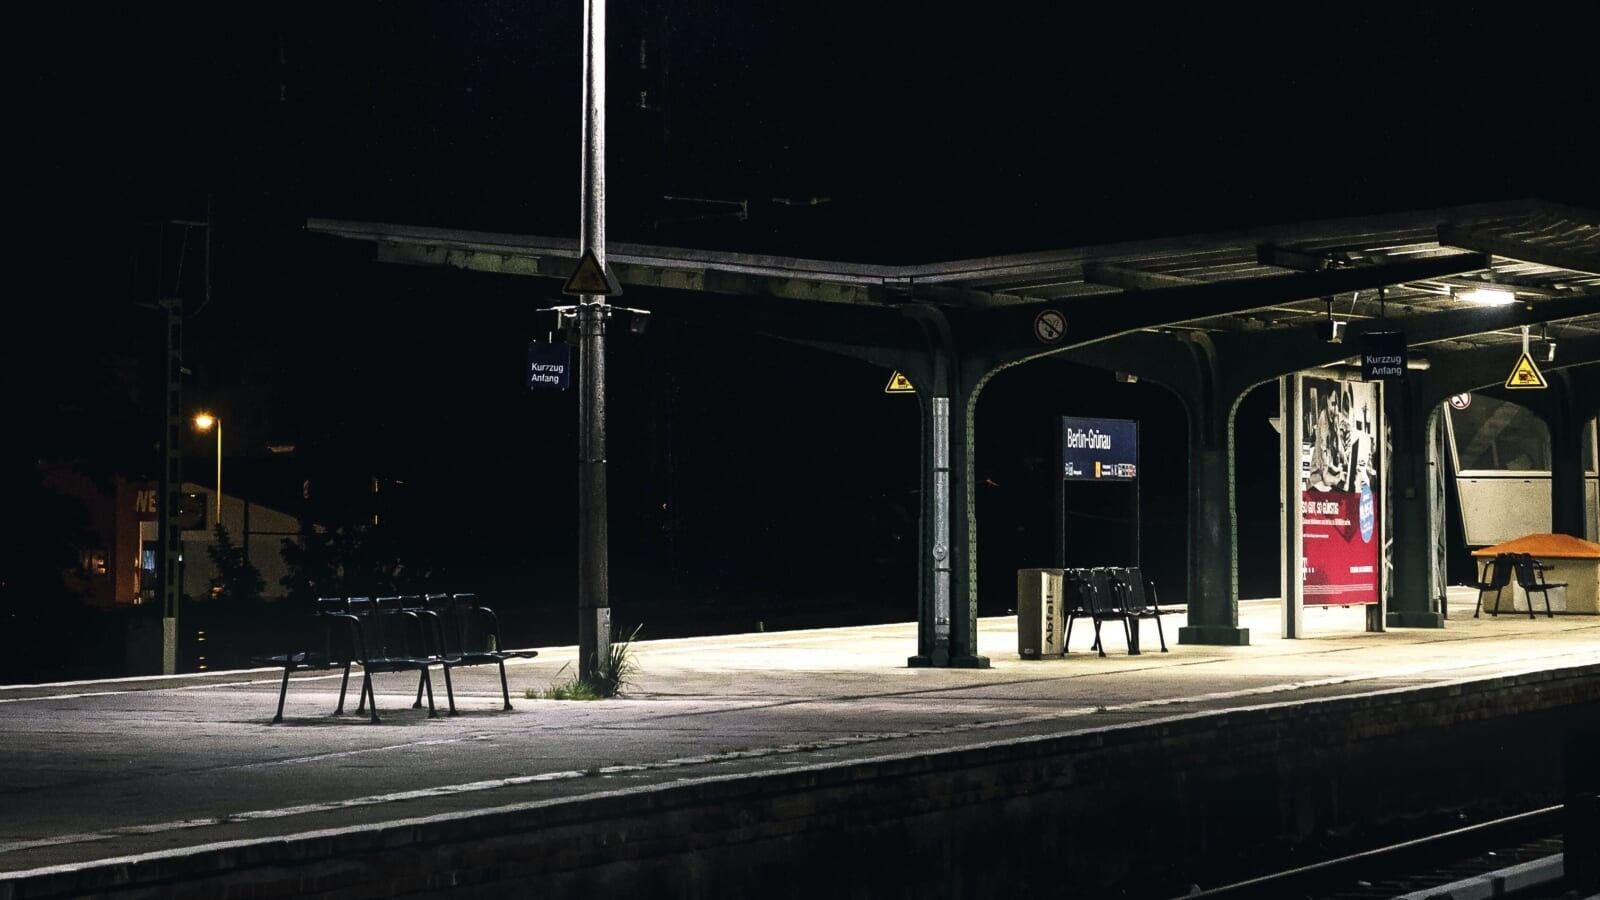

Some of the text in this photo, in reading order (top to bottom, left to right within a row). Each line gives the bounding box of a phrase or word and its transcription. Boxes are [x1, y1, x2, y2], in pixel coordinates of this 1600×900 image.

[1366, 355, 1402, 365] Kurzzug
[531, 362, 564, 374] Kurzzug
[1372, 366, 1402, 376] Anfang
[531, 373, 559, 385] Anfang
[1067, 428, 1111, 449] Berlin-Grünau
[1046, 594, 1054, 645] Abfall
